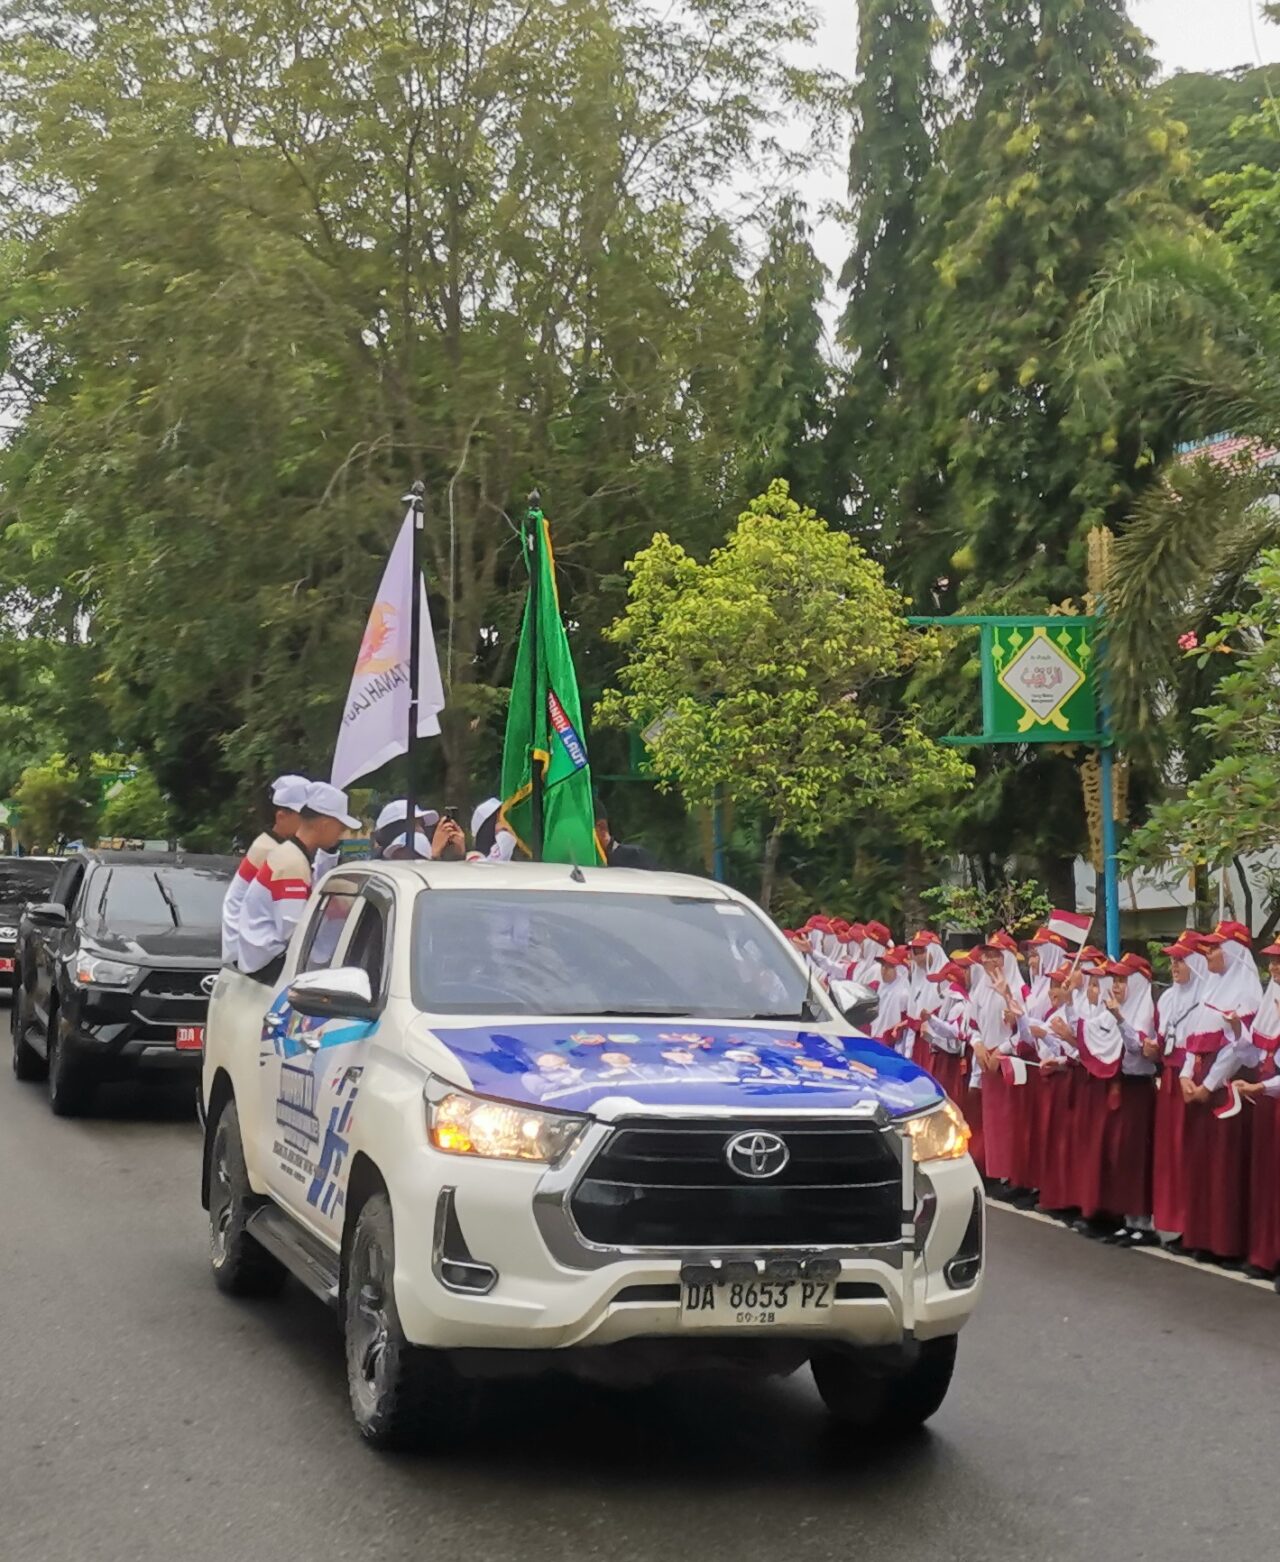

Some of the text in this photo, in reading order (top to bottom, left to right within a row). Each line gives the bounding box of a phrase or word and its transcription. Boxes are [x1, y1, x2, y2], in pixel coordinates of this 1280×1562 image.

[563, 733, 587, 768] LAUT
[686, 1280, 830, 1311] DA 8653 PZ
